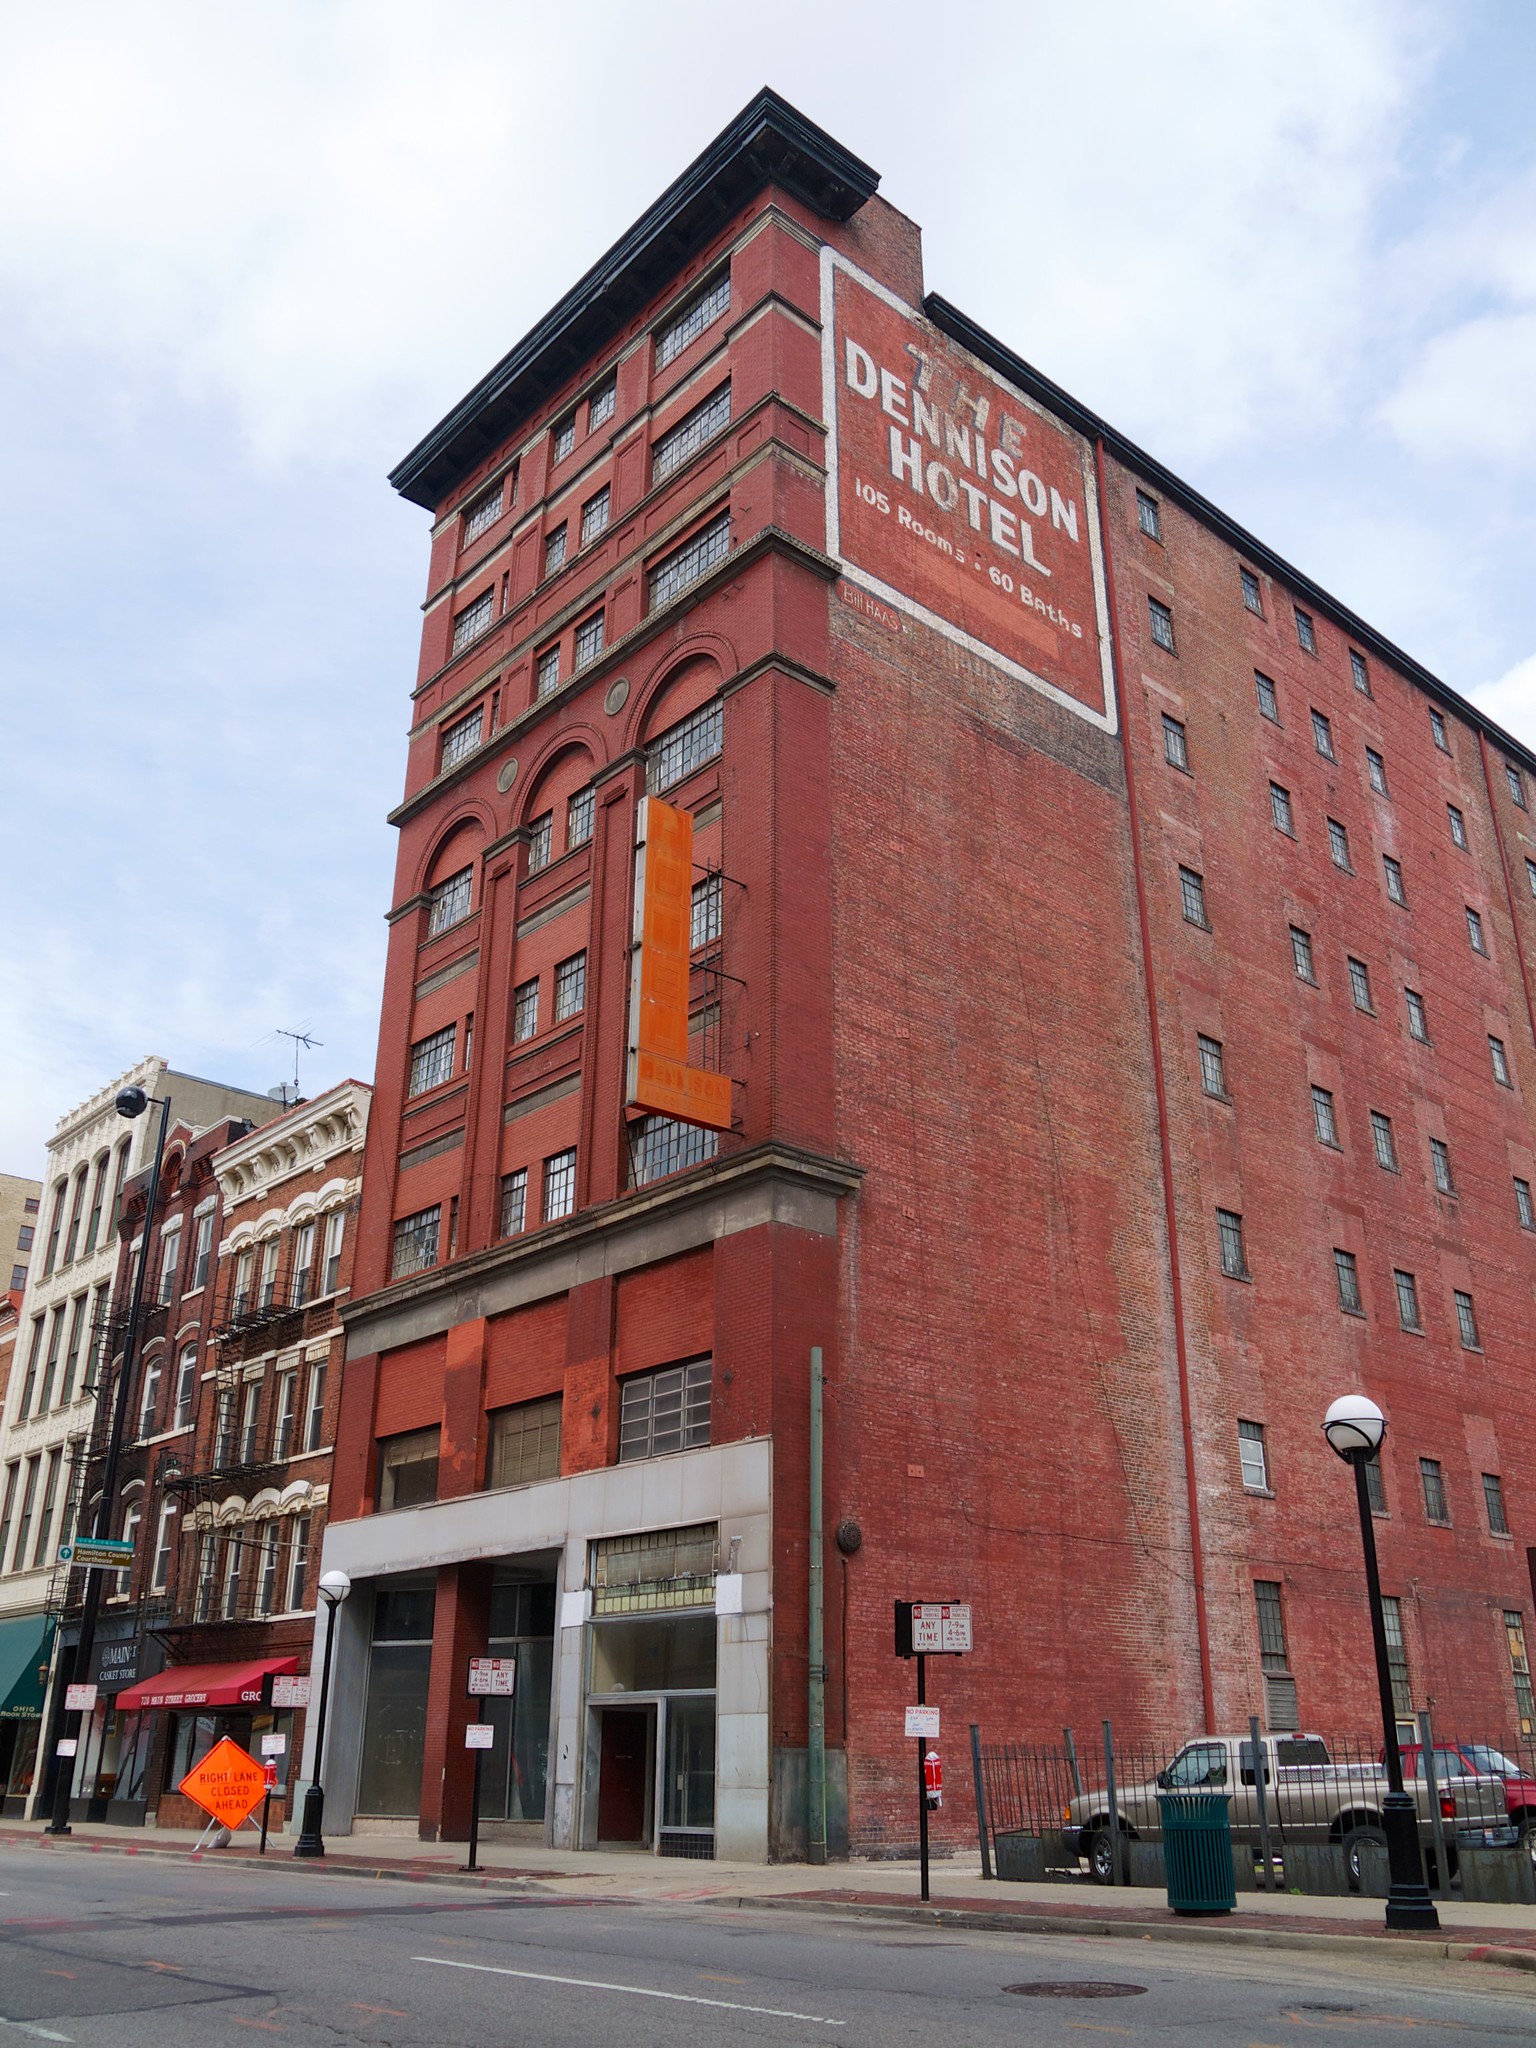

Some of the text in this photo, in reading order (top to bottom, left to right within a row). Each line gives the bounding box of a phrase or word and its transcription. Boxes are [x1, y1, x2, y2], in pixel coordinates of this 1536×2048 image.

[904, 342, 1028, 460] THE
[845, 336, 1079, 543] DENNISON
[889, 425, 1052, 577] HOTEL
[855, 476, 890, 514] 105
[898, 504, 965, 563] Rooms
[988, 566, 1014, 593] 60
[843, 585, 898, 631] Bill HAAS
[76, 1556, 113, 1564] Courthouse
[77, 1549, 131, 1560] Hamilton County
[920, 1621, 936, 1630] ANY
[919, 1633, 938, 1642] TIME
[109, 1646, 131, 1665] MAIN
[99, 1668, 137, 1681] CASKET STORE
[496, 1671, 509, 1679] ANY
[495, 1679, 509, 1687] TIME
[164, 1694, 184, 1705] STREET
[185, 1693, 208, 1703] GROCERY
[12, 1705, 36, 1713] OHIO
[199, 1772, 258, 1783] RIGHT LANE
[211, 1785, 250, 1797] CLOSED
[215, 1799, 248, 1810] AHEAD
